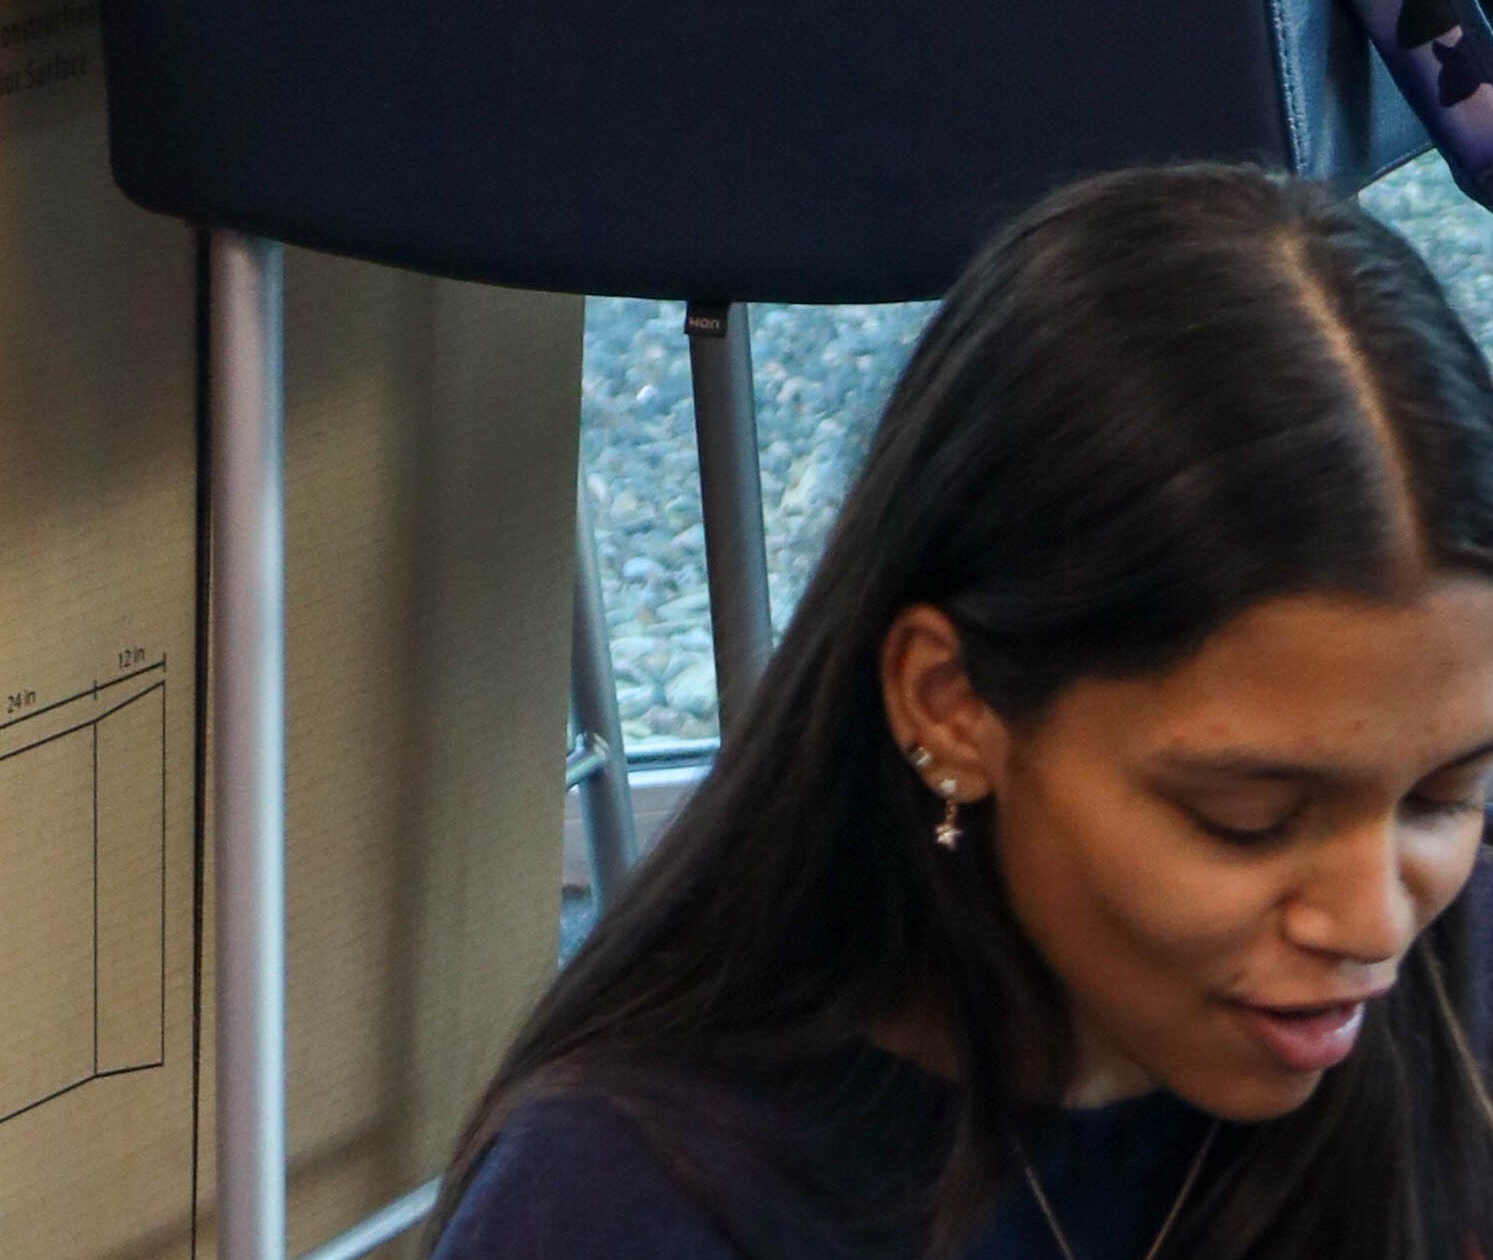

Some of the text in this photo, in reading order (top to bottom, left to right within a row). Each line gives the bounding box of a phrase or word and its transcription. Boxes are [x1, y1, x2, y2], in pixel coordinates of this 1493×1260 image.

[118, 646, 145, 669] 12 in
[8, 690, 36, 713] 24 in
